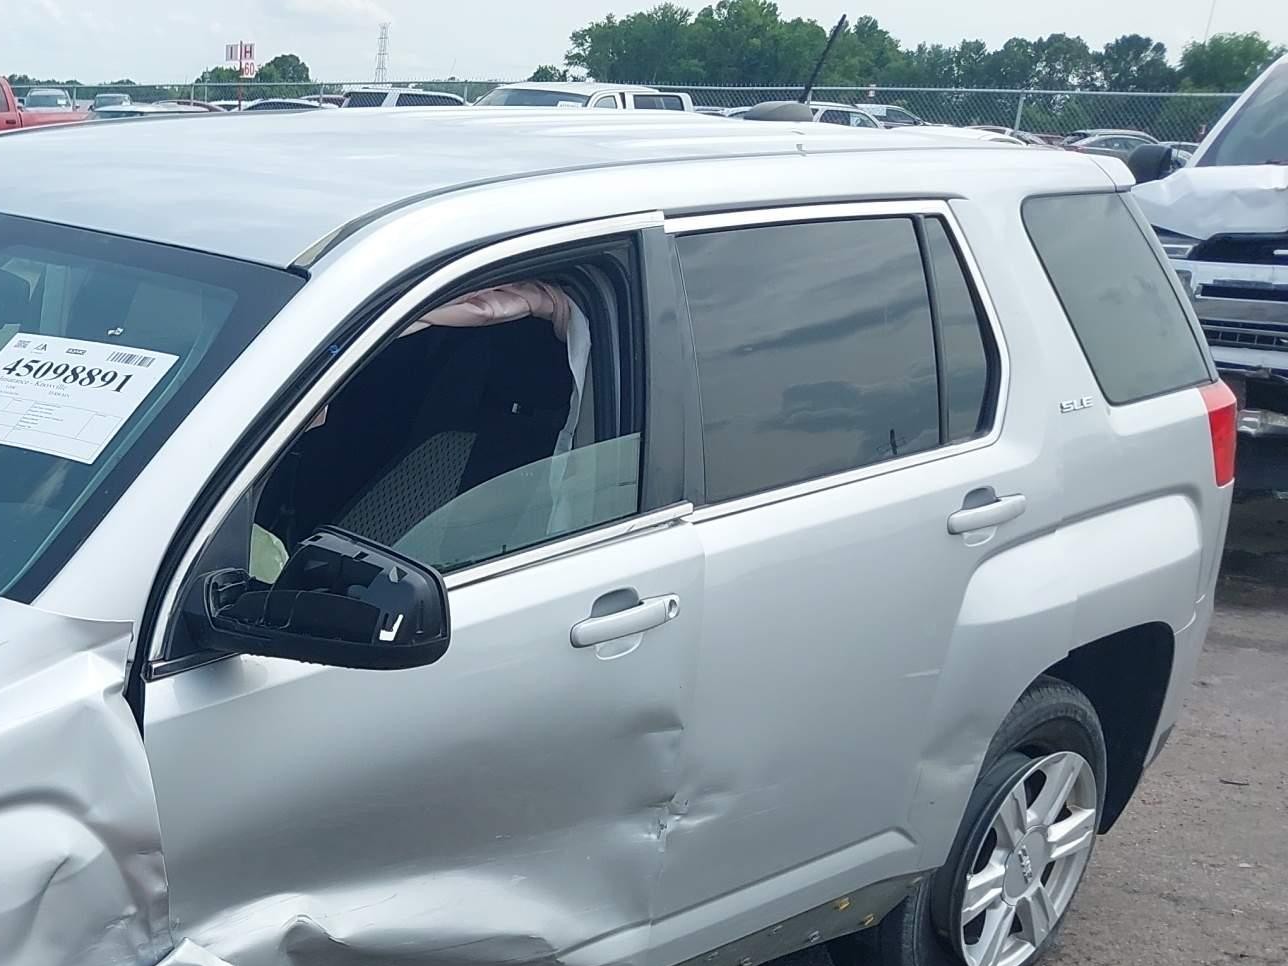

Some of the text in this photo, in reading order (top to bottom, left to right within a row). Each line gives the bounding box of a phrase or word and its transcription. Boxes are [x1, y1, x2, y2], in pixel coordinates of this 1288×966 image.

[244, 44, 253, 59] H
[2, 357, 134, 393] 45098891
[1059, 395, 1094, 414] SLE
